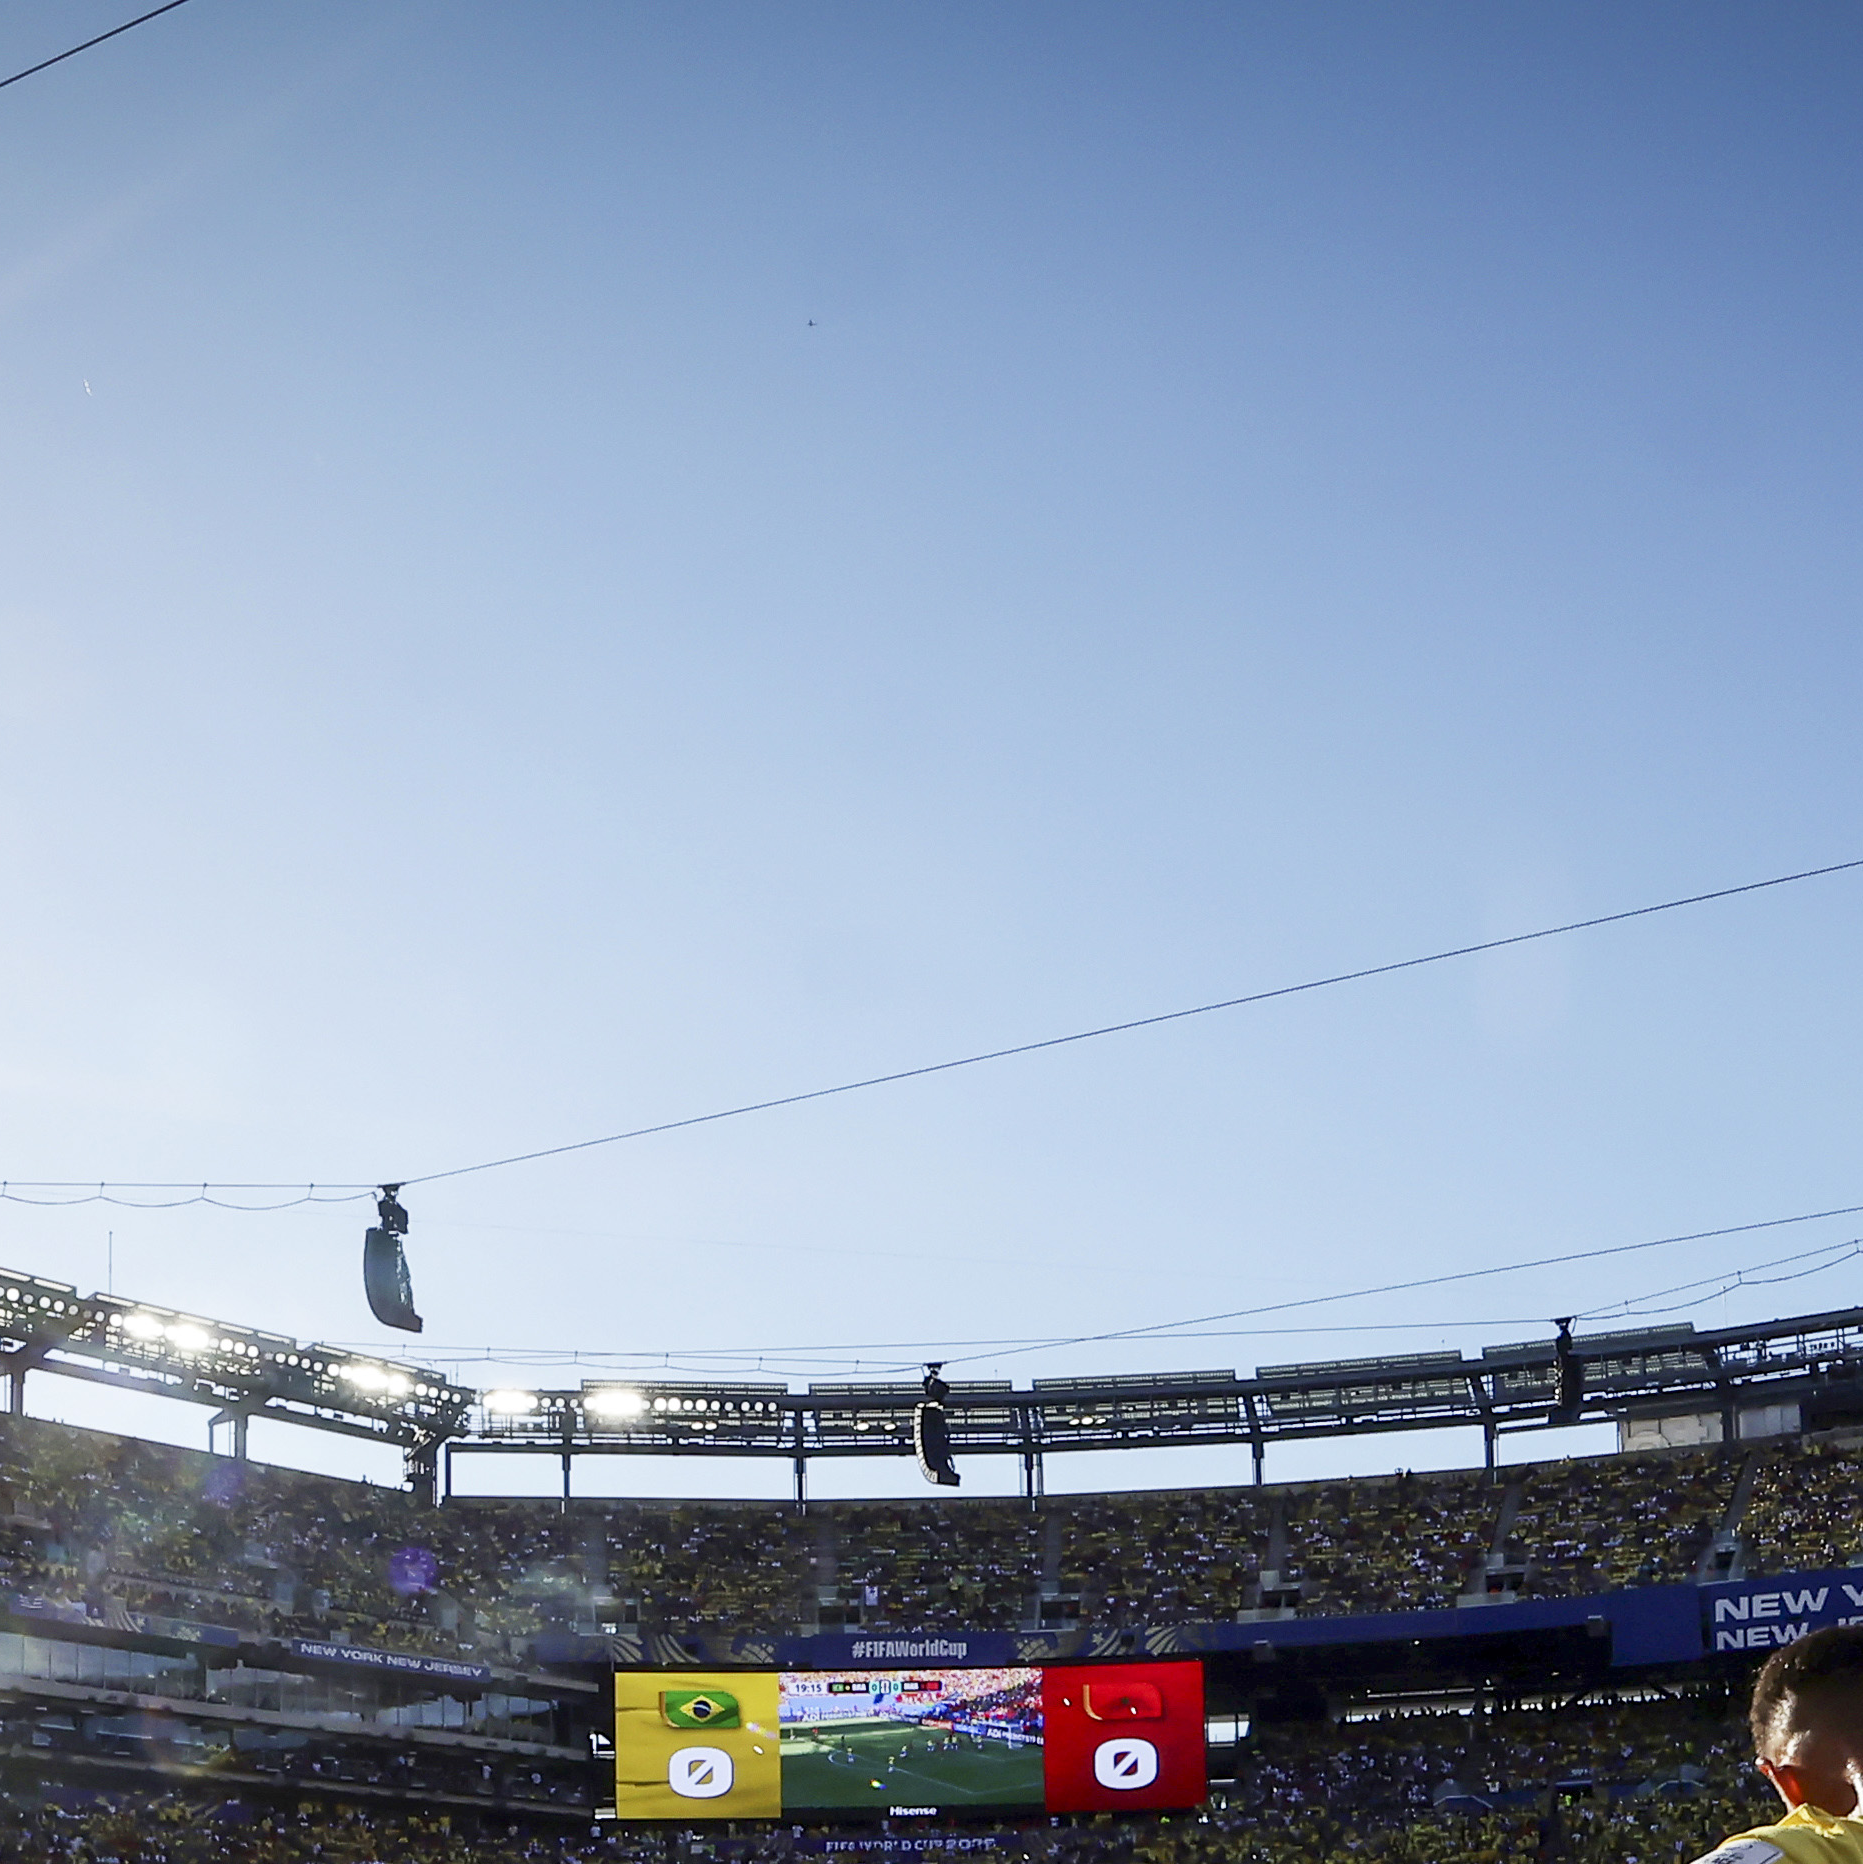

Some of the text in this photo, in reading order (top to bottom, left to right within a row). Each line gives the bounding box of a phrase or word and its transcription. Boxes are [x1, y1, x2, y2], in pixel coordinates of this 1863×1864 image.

[1715, 1587, 1829, 1622] NEW
[852, 1639, 968, 1660] #FIFAWorldCup
[1716, 1622, 1810, 1651] NEW
[300, 1643, 337, 1657] NEW
[340, 1649, 383, 1664] YORK
[386, 1655, 421, 1669] NEW
[795, 1683, 822, 1693] 19:15
[668, 1746, 733, 1798] 0
[1094, 1738, 1158, 1790] 0
[889, 1806, 937, 1816] Hisense
